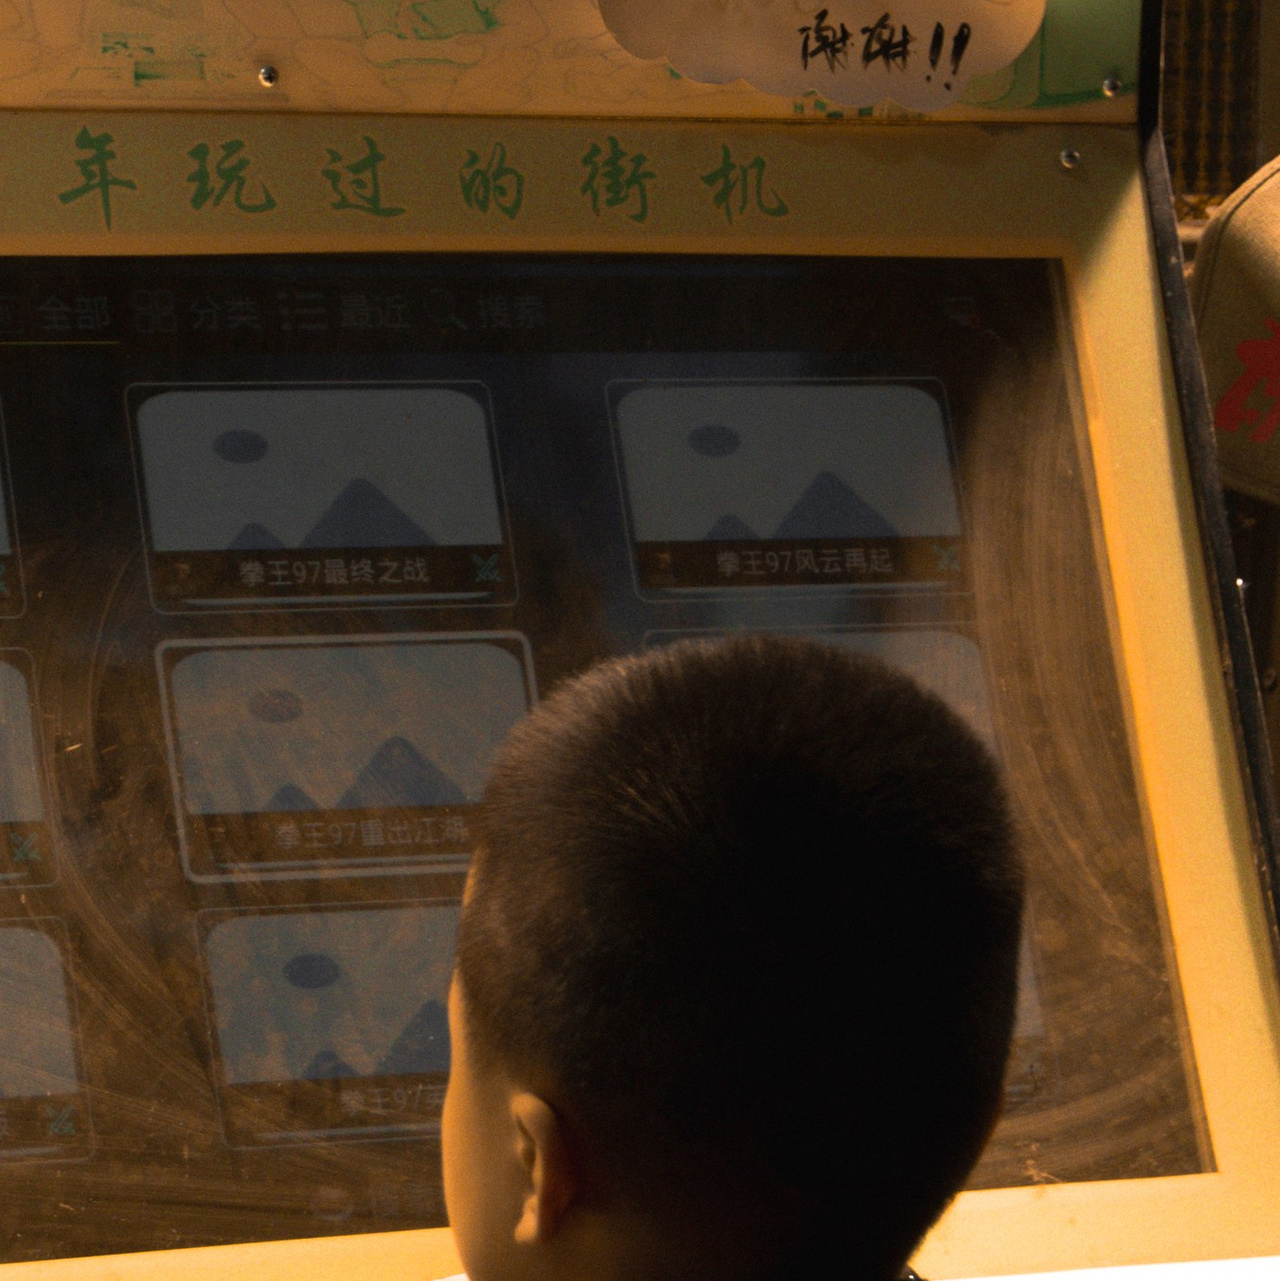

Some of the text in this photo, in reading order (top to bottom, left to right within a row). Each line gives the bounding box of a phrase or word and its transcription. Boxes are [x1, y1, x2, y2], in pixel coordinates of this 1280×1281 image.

[36, 294, 110, 332] 全部
[189, 294, 263, 334] 分类
[340, 293, 410, 332] 最近
[477, 293, 547, 334] 搜索
[239, 557, 431, 588] 拳王97最终之战
[715, 546, 894, 577] 拳王97风云再起
